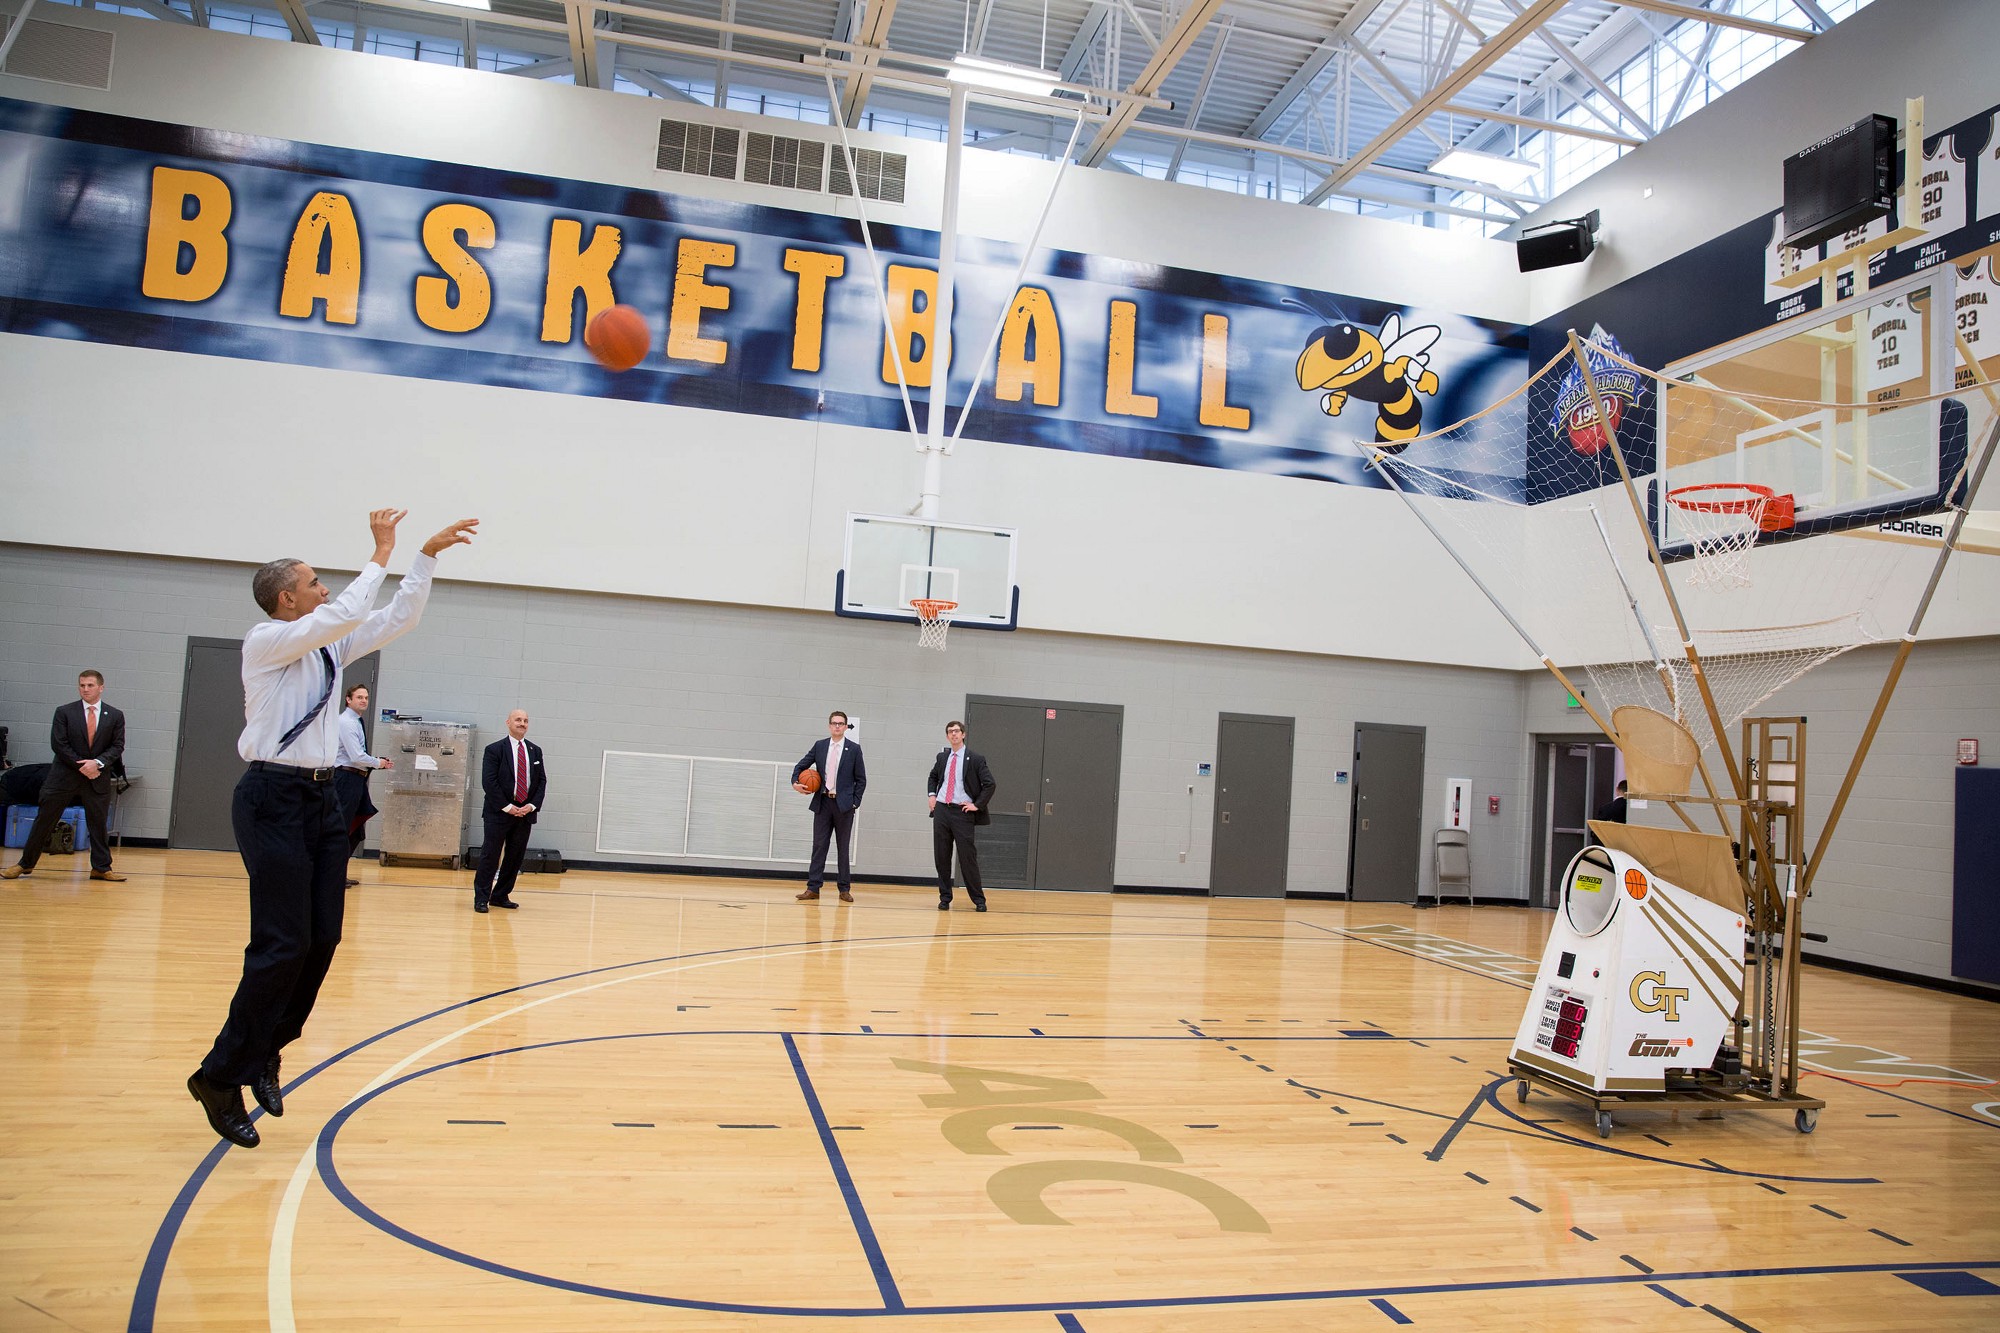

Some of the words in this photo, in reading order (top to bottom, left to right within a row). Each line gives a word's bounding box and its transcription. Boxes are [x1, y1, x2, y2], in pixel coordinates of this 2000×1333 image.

[1799, 124, 1857, 158] DAKTRONICS
[1920, 243, 1941, 258] PAUL
[1914, 250, 1947, 270] HEWITT
[141, 165, 1252, 431] BASKETBALL
[1780, 295, 1802, 310] BOBBY
[1776, 304, 1806, 321] CREMINS
[1957, 309, 1978, 330] 33
[1871, 319, 1907, 340] GEORGIA
[1881, 335, 1898, 354] 10
[1876, 354, 1900, 370] TECH
[1610, 374, 1636, 392] FOUR
[1877, 388, 1901, 402] CRAIG
[1546, 999, 1560, 1008] SHOTS
[1629, 970, 1689, 1022] GT
[1545, 1004, 1559, 1013] MADE
[1574, 1007, 1585, 1022] 0
[1541, 1021, 1556, 1030] SHOTS
[1542, 1016, 1557, 1025] TOTAL
[1537, 1033, 1553, 1041] PERCENT
[1571, 1024, 1581, 1040] 3
[1536, 1038, 1552, 1048] MADE
[1567, 1042, 1578, 1057] 0
[1628, 1039, 1681, 1057] GUN
[889, 1056, 1273, 1235] ACC
